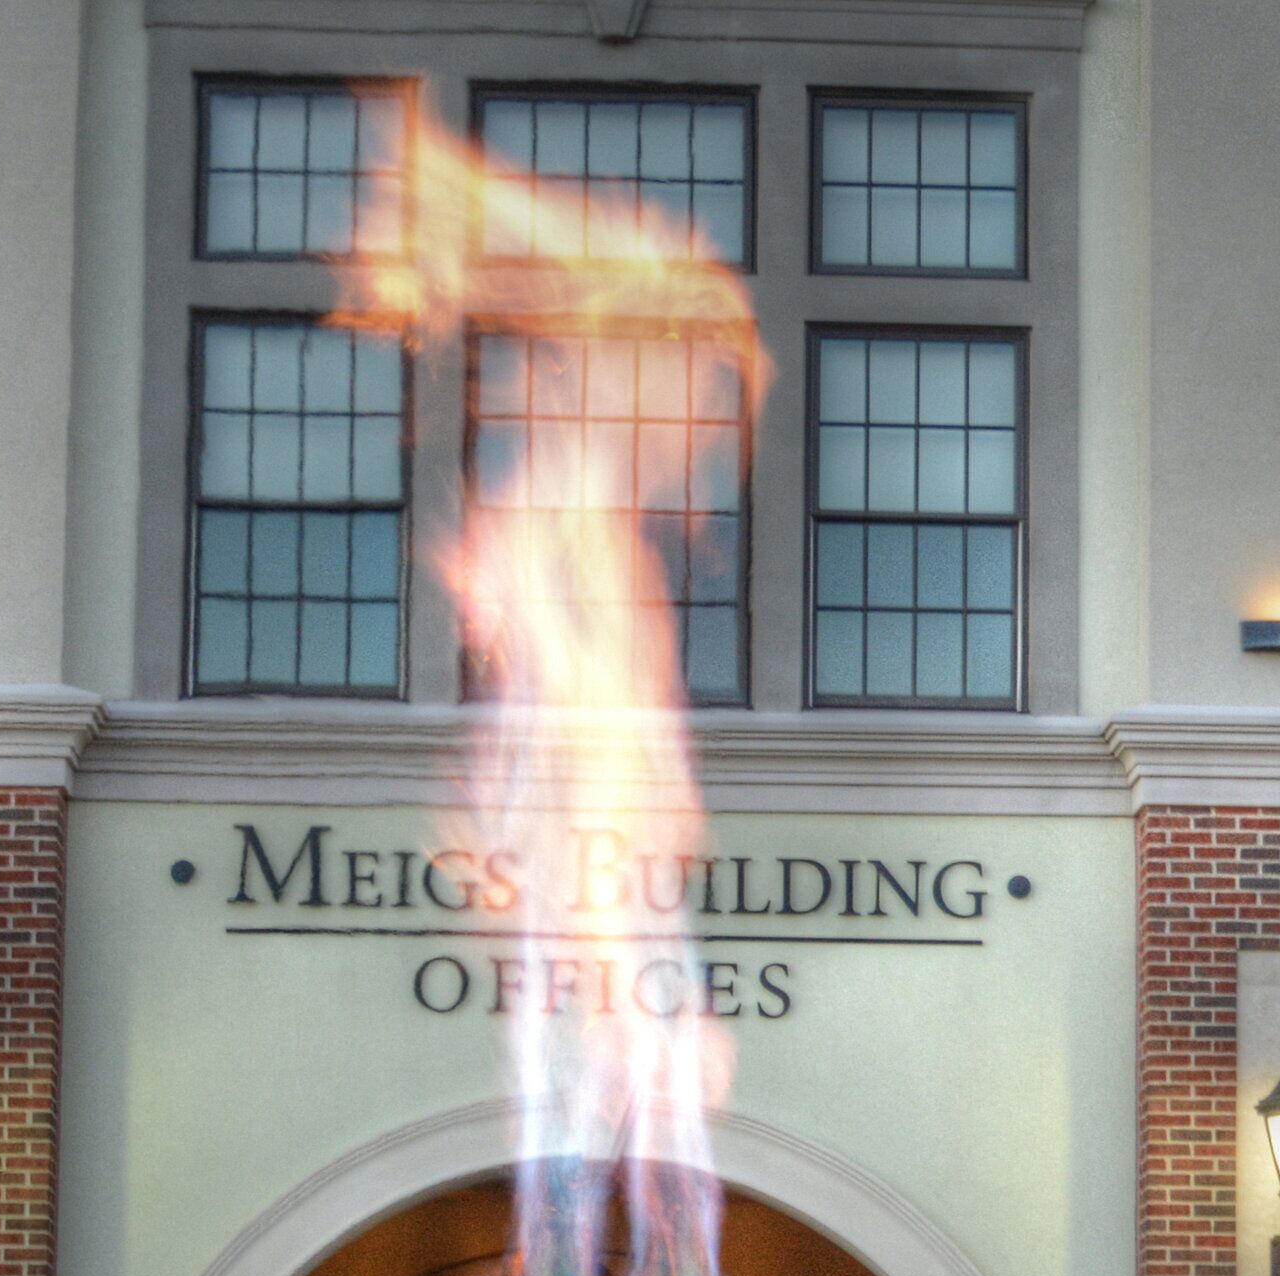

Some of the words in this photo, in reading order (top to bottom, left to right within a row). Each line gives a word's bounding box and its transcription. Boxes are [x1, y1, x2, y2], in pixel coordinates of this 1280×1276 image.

[225, 824, 518, 912] MEIGS
[567, 826, 989, 919] BUILDING
[412, 955, 793, 1019] OFFICES
